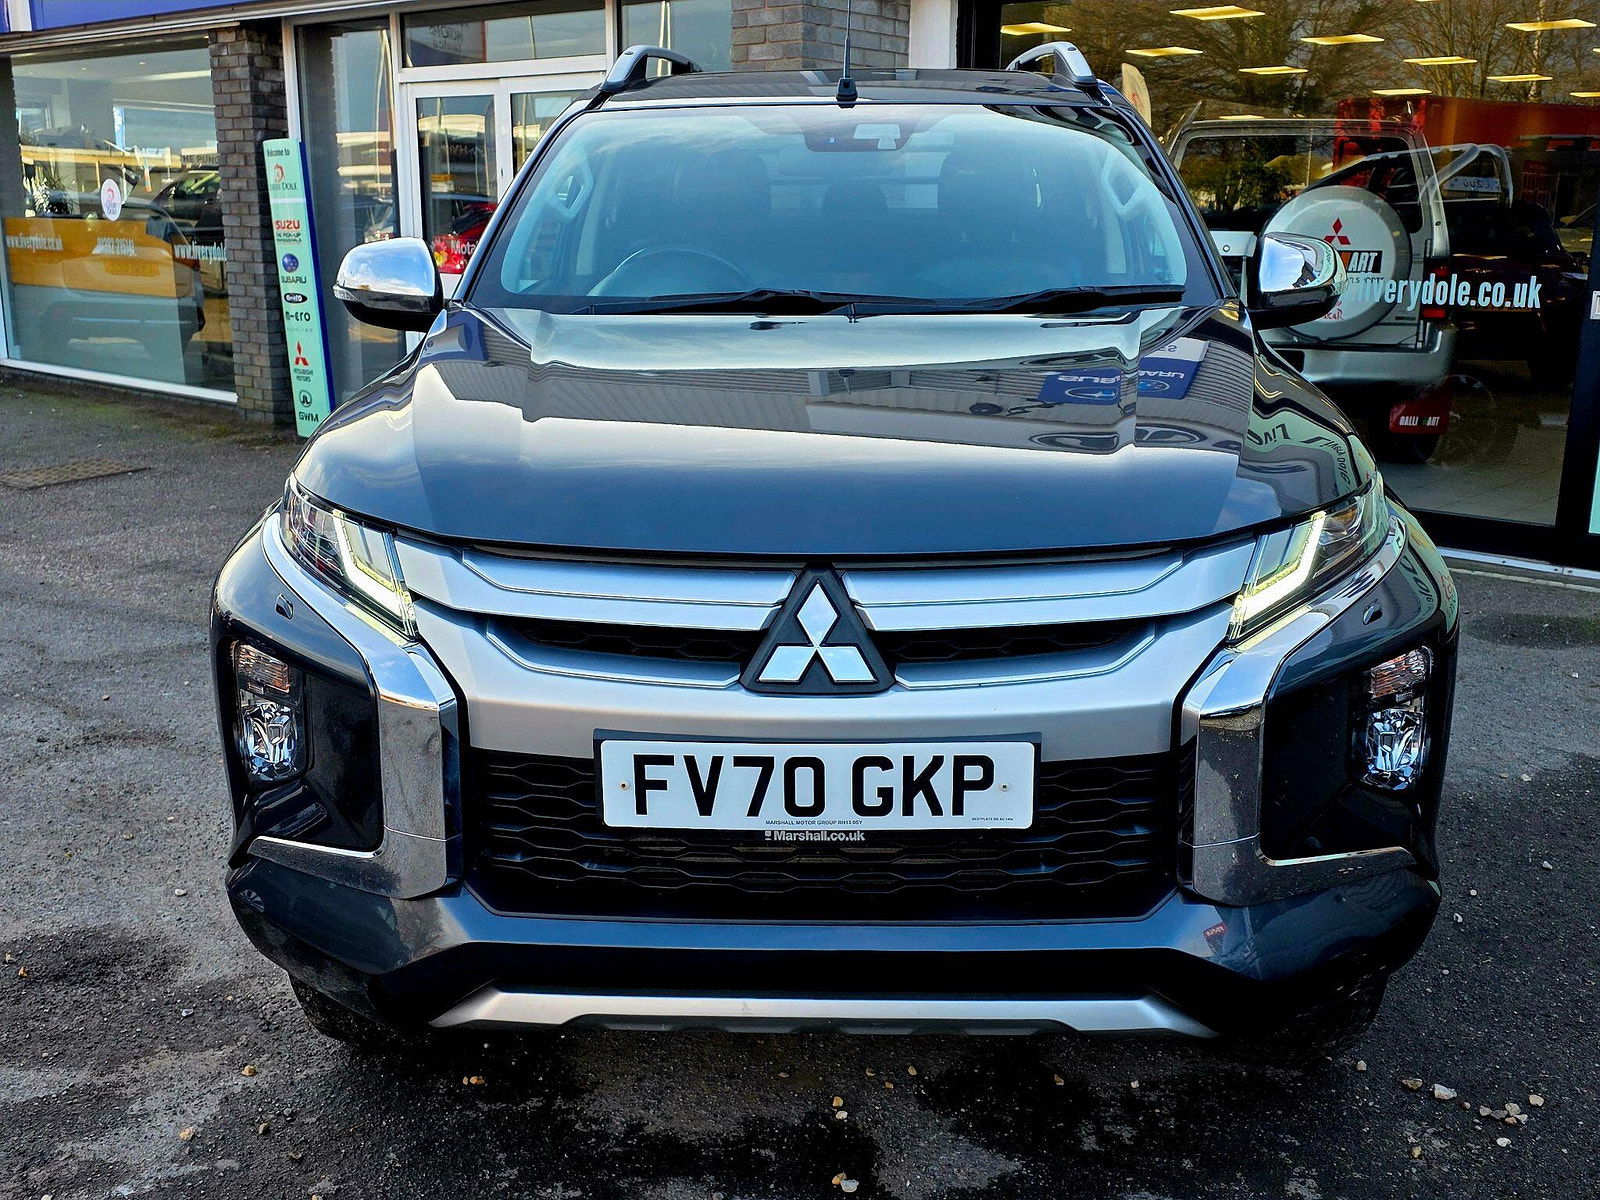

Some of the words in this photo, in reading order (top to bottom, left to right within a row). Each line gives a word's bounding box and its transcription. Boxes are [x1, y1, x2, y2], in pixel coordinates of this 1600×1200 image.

[451, 239, 479, 255] Mota
[298, 411, 319, 422] GWM
[633, 753, 825, 818] FV70
[851, 754, 995, 818] GKP
[773, 830, 866, 841] Marshall.co.uk
